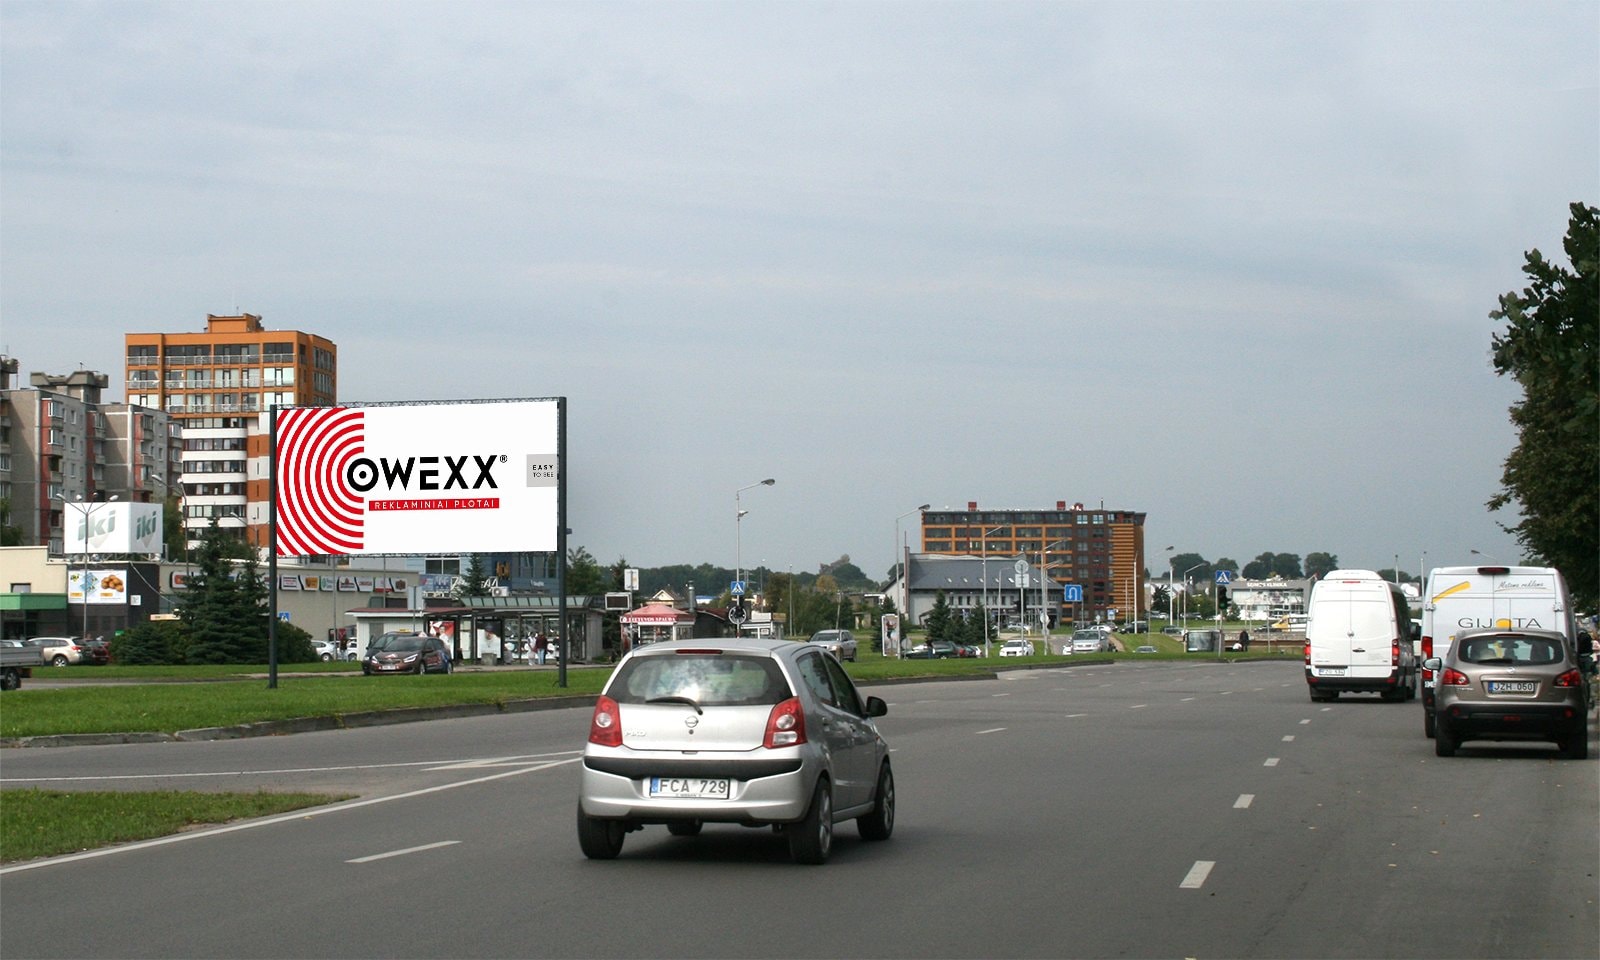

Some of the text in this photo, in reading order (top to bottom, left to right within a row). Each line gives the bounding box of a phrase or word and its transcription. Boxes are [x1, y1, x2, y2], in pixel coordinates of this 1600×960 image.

[374, 499, 495, 510] REKLAMINIAI PLOTAI
[136, 511, 157, 540] iki
[1494, 682, 1533, 691] JZH 050
[660, 780, 727, 793] FCA 729
